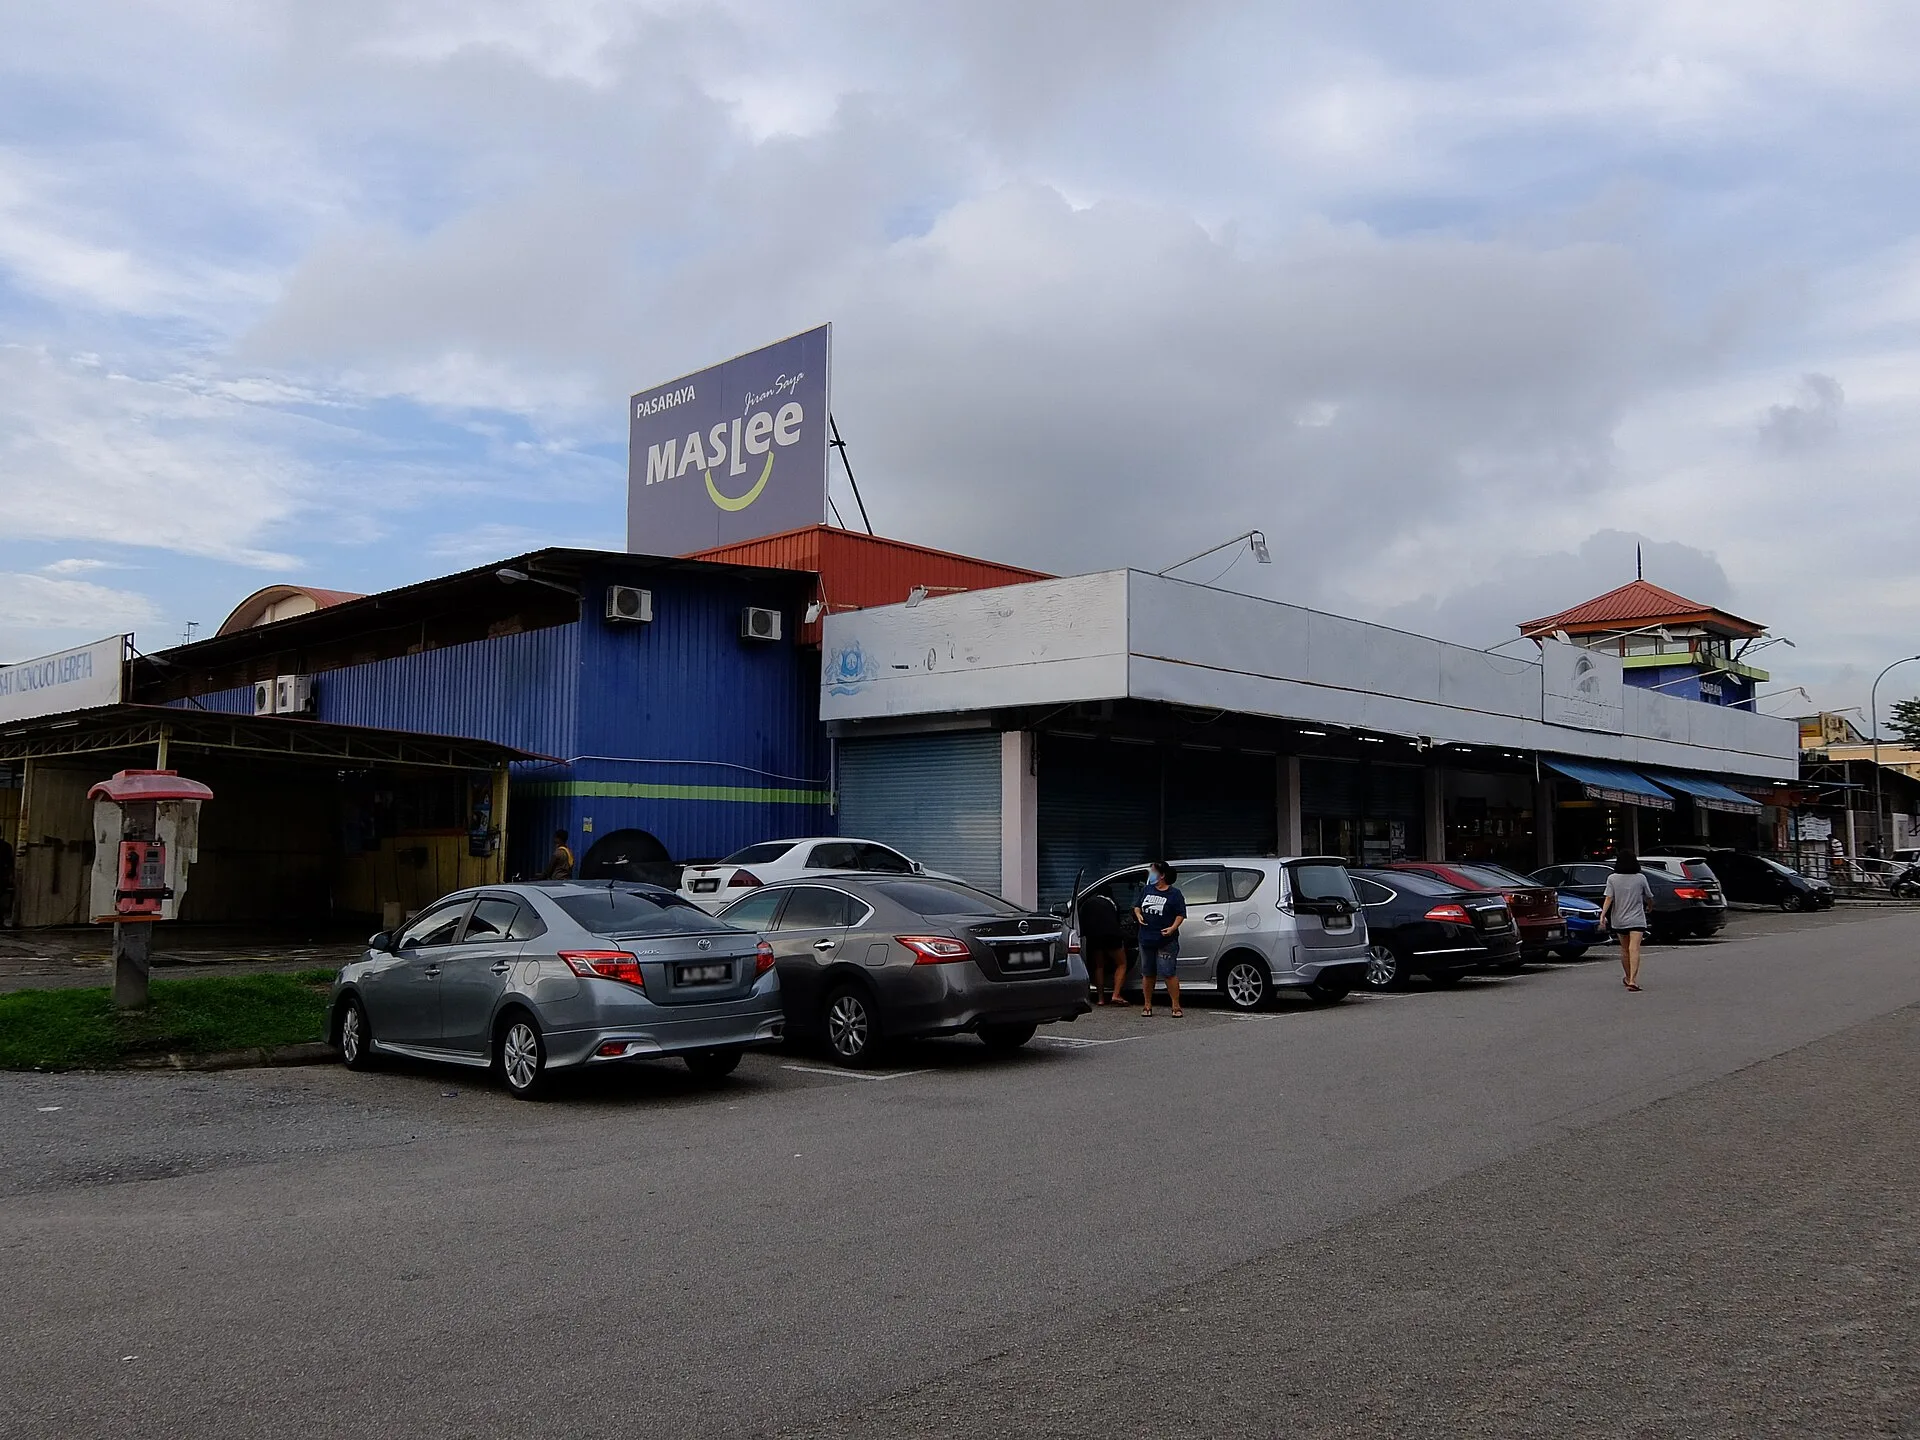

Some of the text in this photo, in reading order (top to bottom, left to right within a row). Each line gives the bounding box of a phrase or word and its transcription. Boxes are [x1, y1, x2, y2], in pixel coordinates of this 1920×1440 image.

[775, 371, 804, 395] Saya
[636, 384, 696, 419] PASARAYA
[58, 651, 93, 685] KERETA
